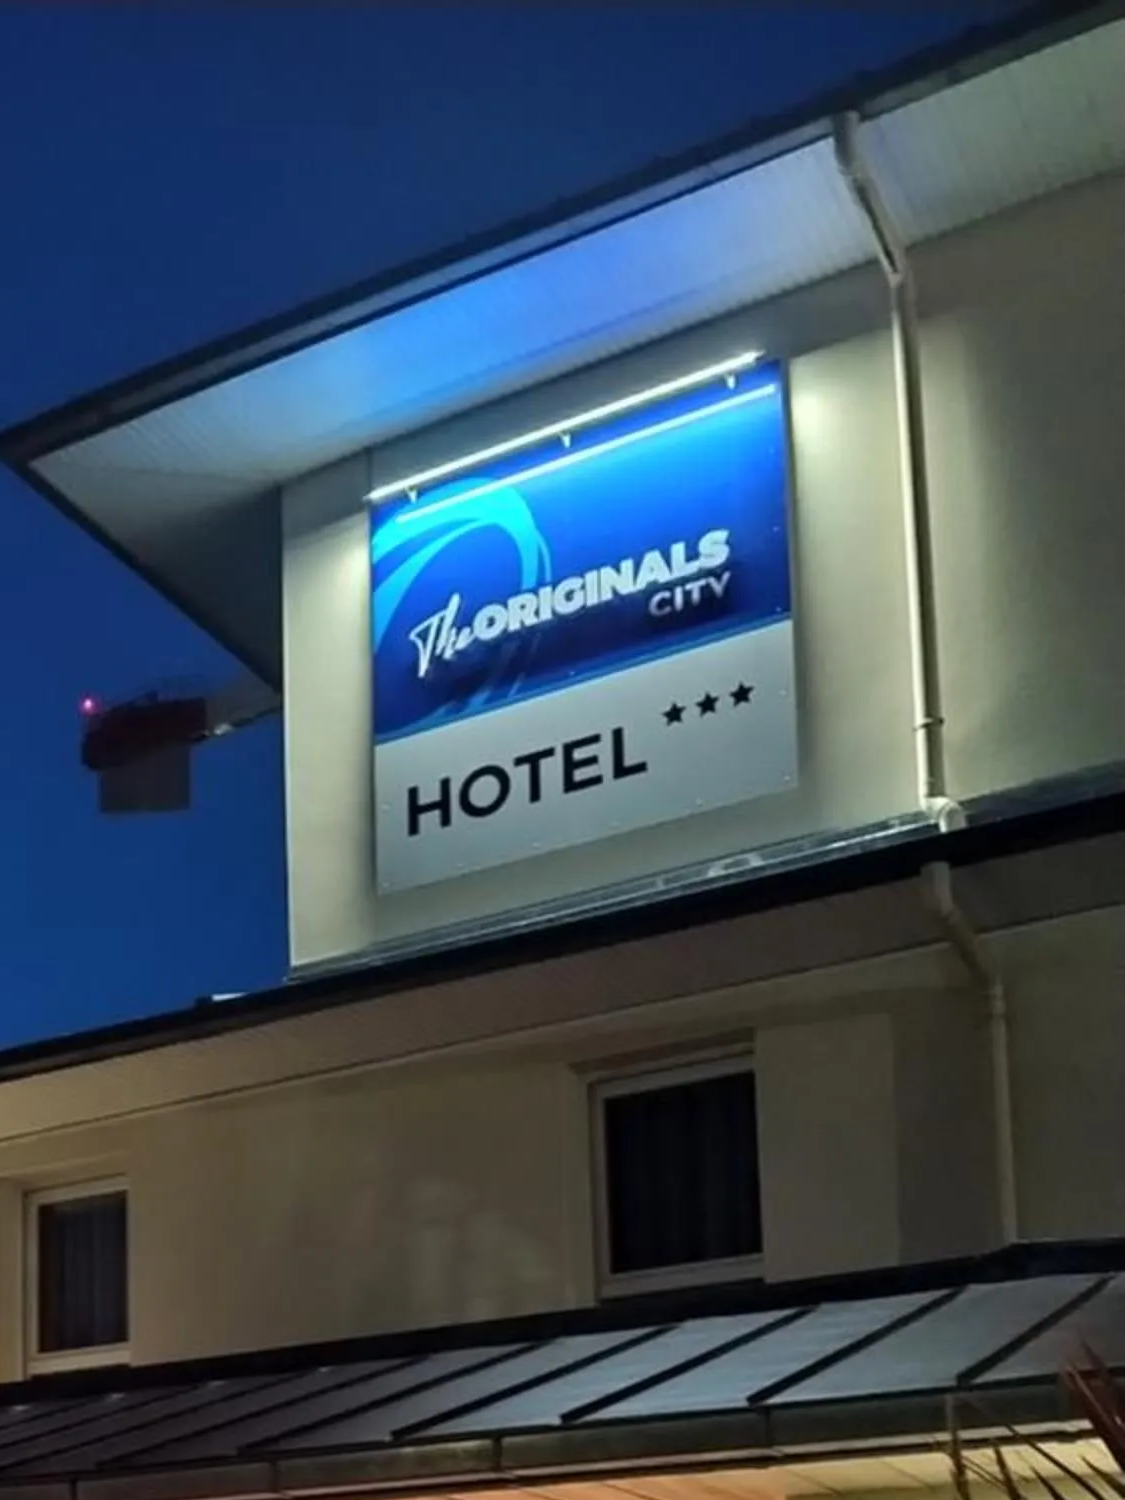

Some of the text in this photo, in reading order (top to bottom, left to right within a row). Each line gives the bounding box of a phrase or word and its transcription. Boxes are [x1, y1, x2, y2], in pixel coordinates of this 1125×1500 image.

[410, 529, 730, 678] The ORIGINALS
[649, 571, 731, 617] CITY
[407, 727, 647, 836] HOTEL
